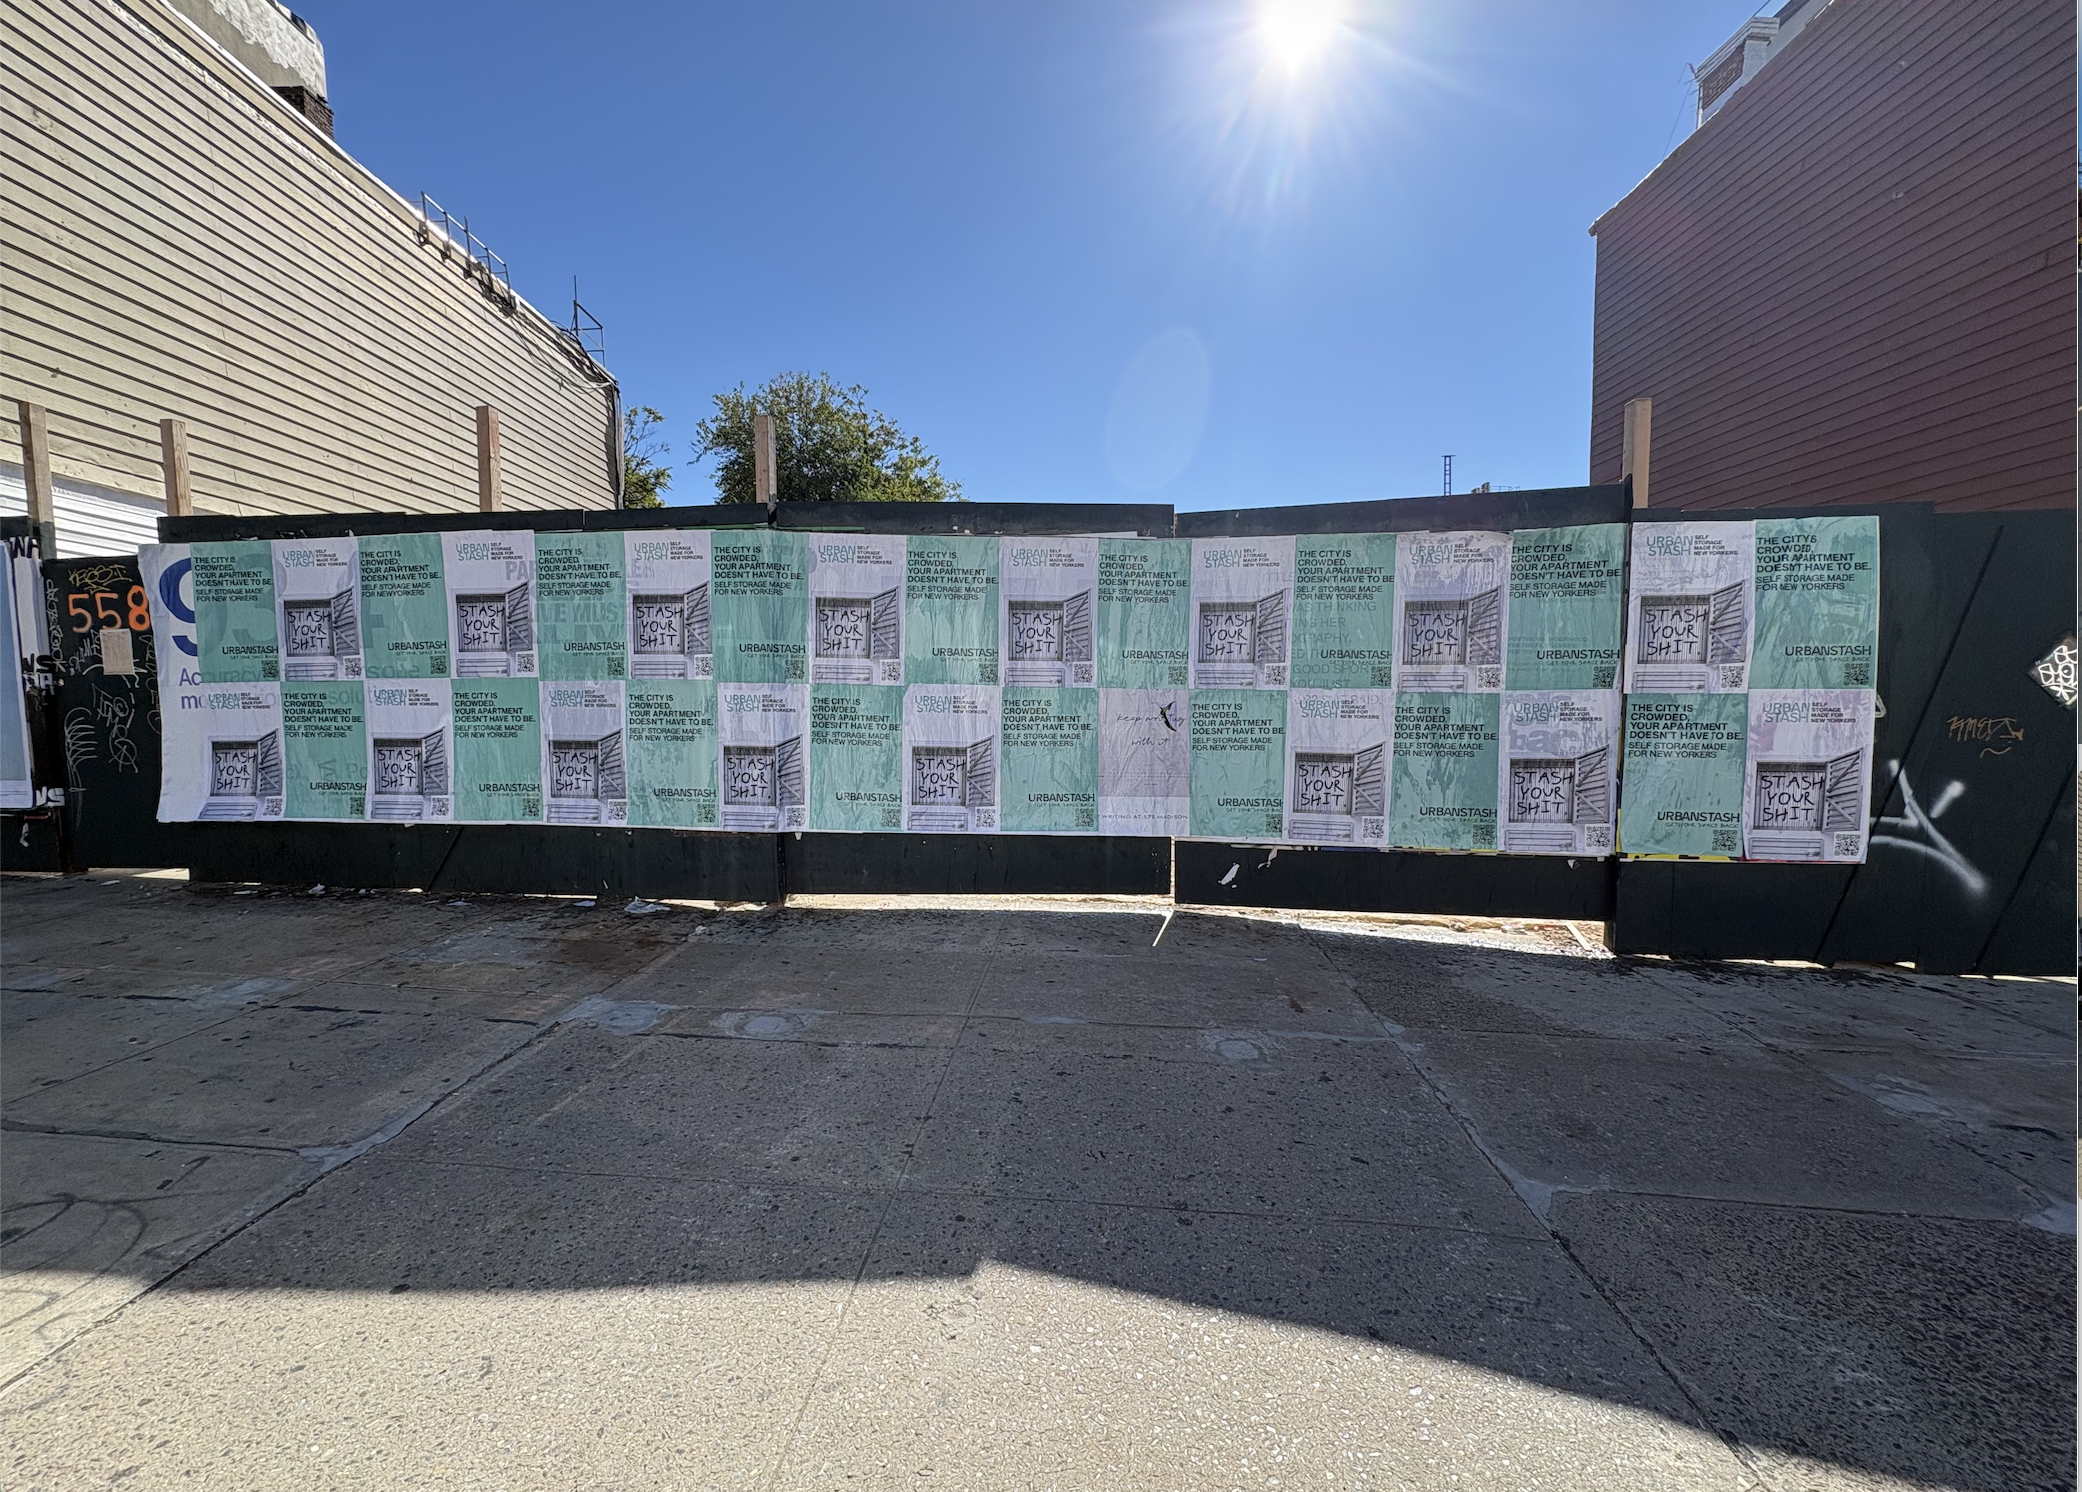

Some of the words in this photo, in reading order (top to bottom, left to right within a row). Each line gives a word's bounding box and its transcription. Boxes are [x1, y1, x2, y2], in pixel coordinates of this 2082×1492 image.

[1647, 536, 1693, 547] URBAN
[1648, 546, 1691, 556] STASH
[739, 563, 791, 571] APARTMENT
[68, 585, 150, 633] 558
[636, 606, 683, 618] STASH
[289, 610, 331, 623] STASH
[1012, 612, 1063, 626] STASH
[1646, 608, 1709, 622] STASH
[292, 624, 326, 636] YOUR
[641, 620, 676, 632] YOUR
[1017, 627, 1054, 640] YOUR
[1651, 625, 1698, 639] YOUR
[292, 638, 330, 650] SHIT.
[388, 640, 447, 650] URBANSTASH
[564, 641, 625, 651] URBANSTASH
[640, 635, 680, 647] SHIT.
[739, 644, 806, 654] URBANSTASH
[1015, 641, 1058, 654] SHIT.
[1647, 641, 1701, 656] SHIT.
[1785, 645, 1872, 657] URBANSTASH
[1122, 650, 1189, 659] URBANSTASH
[1537, 649, 1620, 659] URBANSTASH
[1632, 704, 1652, 712] THE
[1655, 704, 1680, 712] CITY
[1763, 703, 1810, 713] URBAN
[1765, 713, 1808, 723] STASH
[1132, 737, 1154, 745] with
[1630, 731, 1677, 739] DOESN'T
[1727, 732, 1744, 740] BE.
[1654, 742, 1700, 750] STORAGE
[552, 751, 598, 764] STASH
[557, 766, 592, 777] YOUR
[1300, 764, 1353, 778] STASH
[556, 778, 595, 792] SHIT.
[1304, 779, 1344, 792] YOUR
[1761, 775, 1825, 789] STASH
[479, 784, 540, 792] URBANSTASH
[654, 788, 716, 797] URBANSTASH
[836, 792, 902, 802] URBANSTASH
[1029, 794, 1095, 802] URBANSTASH
[1217, 798, 1282, 807] URBANSTASH
[1300, 793, 1347, 807] SHIT.
[1767, 792, 1814, 806] YOUR
[1420, 807, 1497, 818] URBANSTASH
[1657, 811, 1740, 822] URBANSTASH
[1764, 808, 1817, 822] SHIT.
